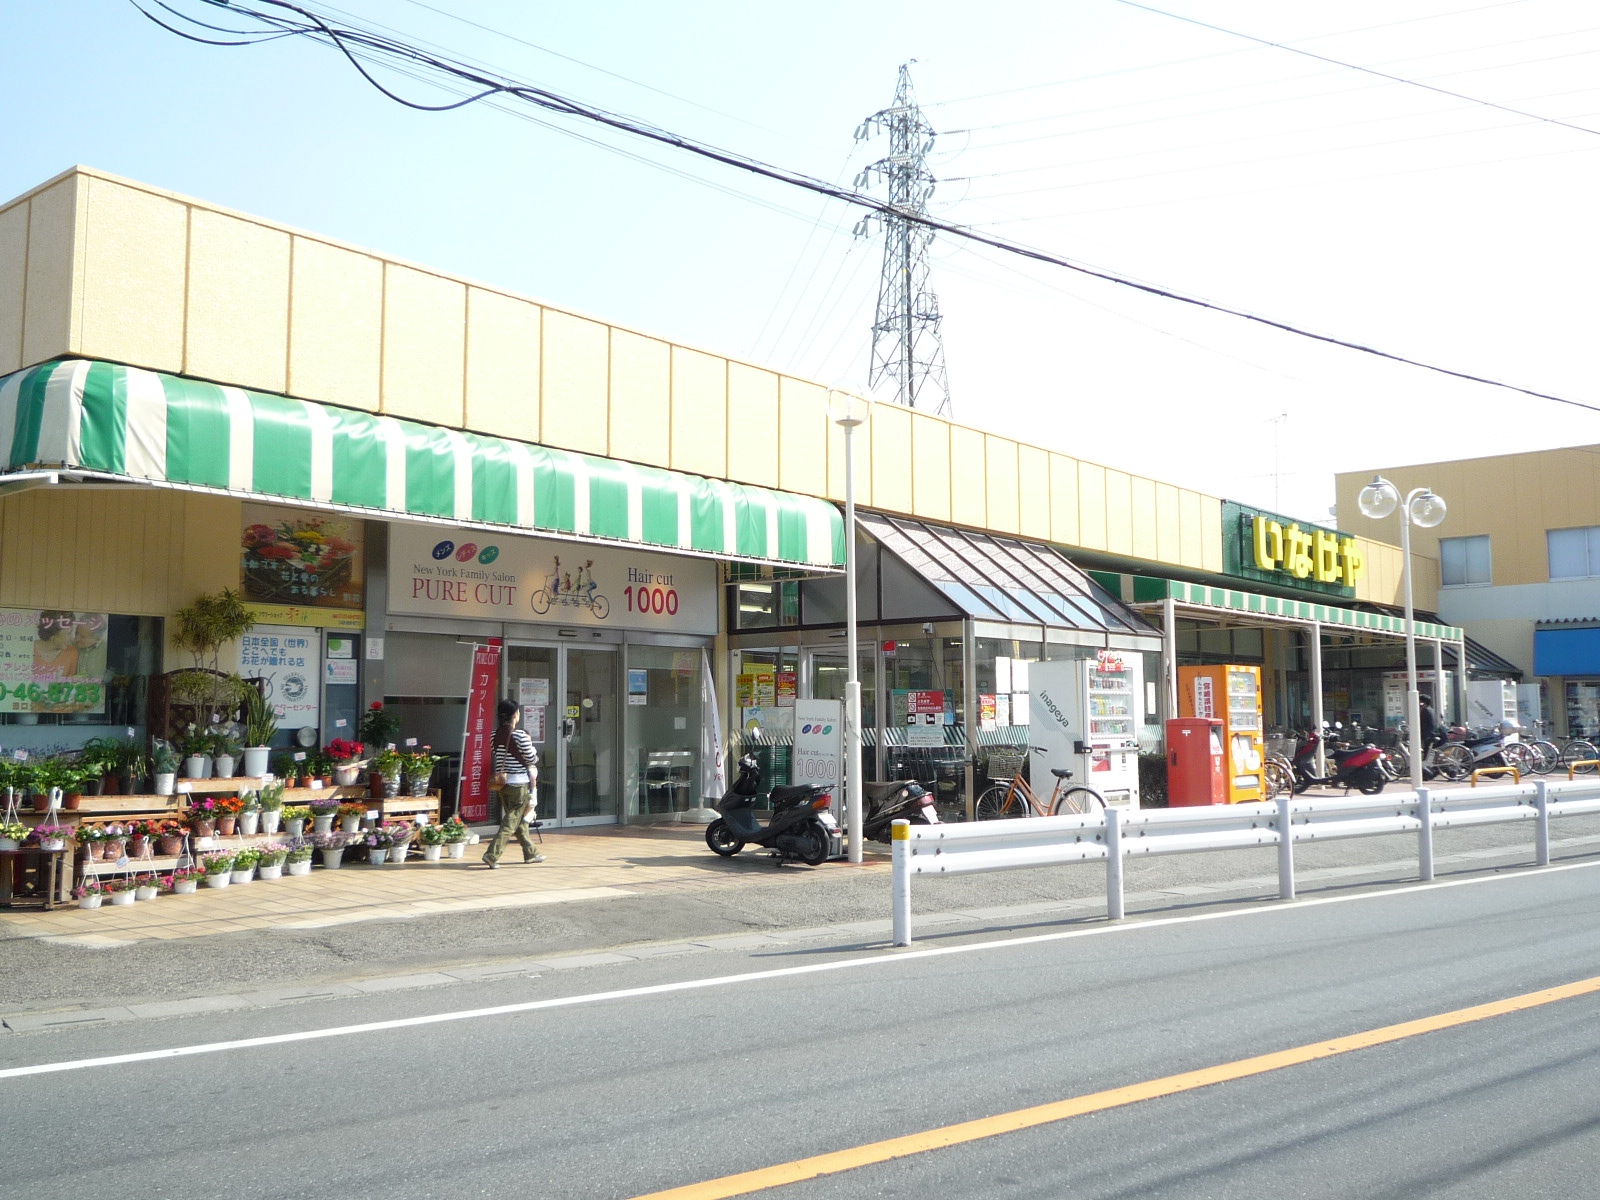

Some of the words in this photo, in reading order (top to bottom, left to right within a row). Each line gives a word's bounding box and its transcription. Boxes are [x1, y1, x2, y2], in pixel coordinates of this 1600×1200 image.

[1253, 516, 1364, 587] いなげや
[413, 564, 434, 575] New
[436, 566, 458, 577] York
[460, 569, 489, 582] Family
[492, 571, 516, 583] Salon
[628, 567, 653, 584] Hair
[656, 573, 673, 586] cut
[412, 577, 467, 602] PURE
[475, 583, 517, 606] CUT
[624, 585, 678, 615] 1000
[1039, 690, 1069, 728] inageya
[470, 672, 489, 797] カット専門美容室
[797, 758, 837, 779] 1000
